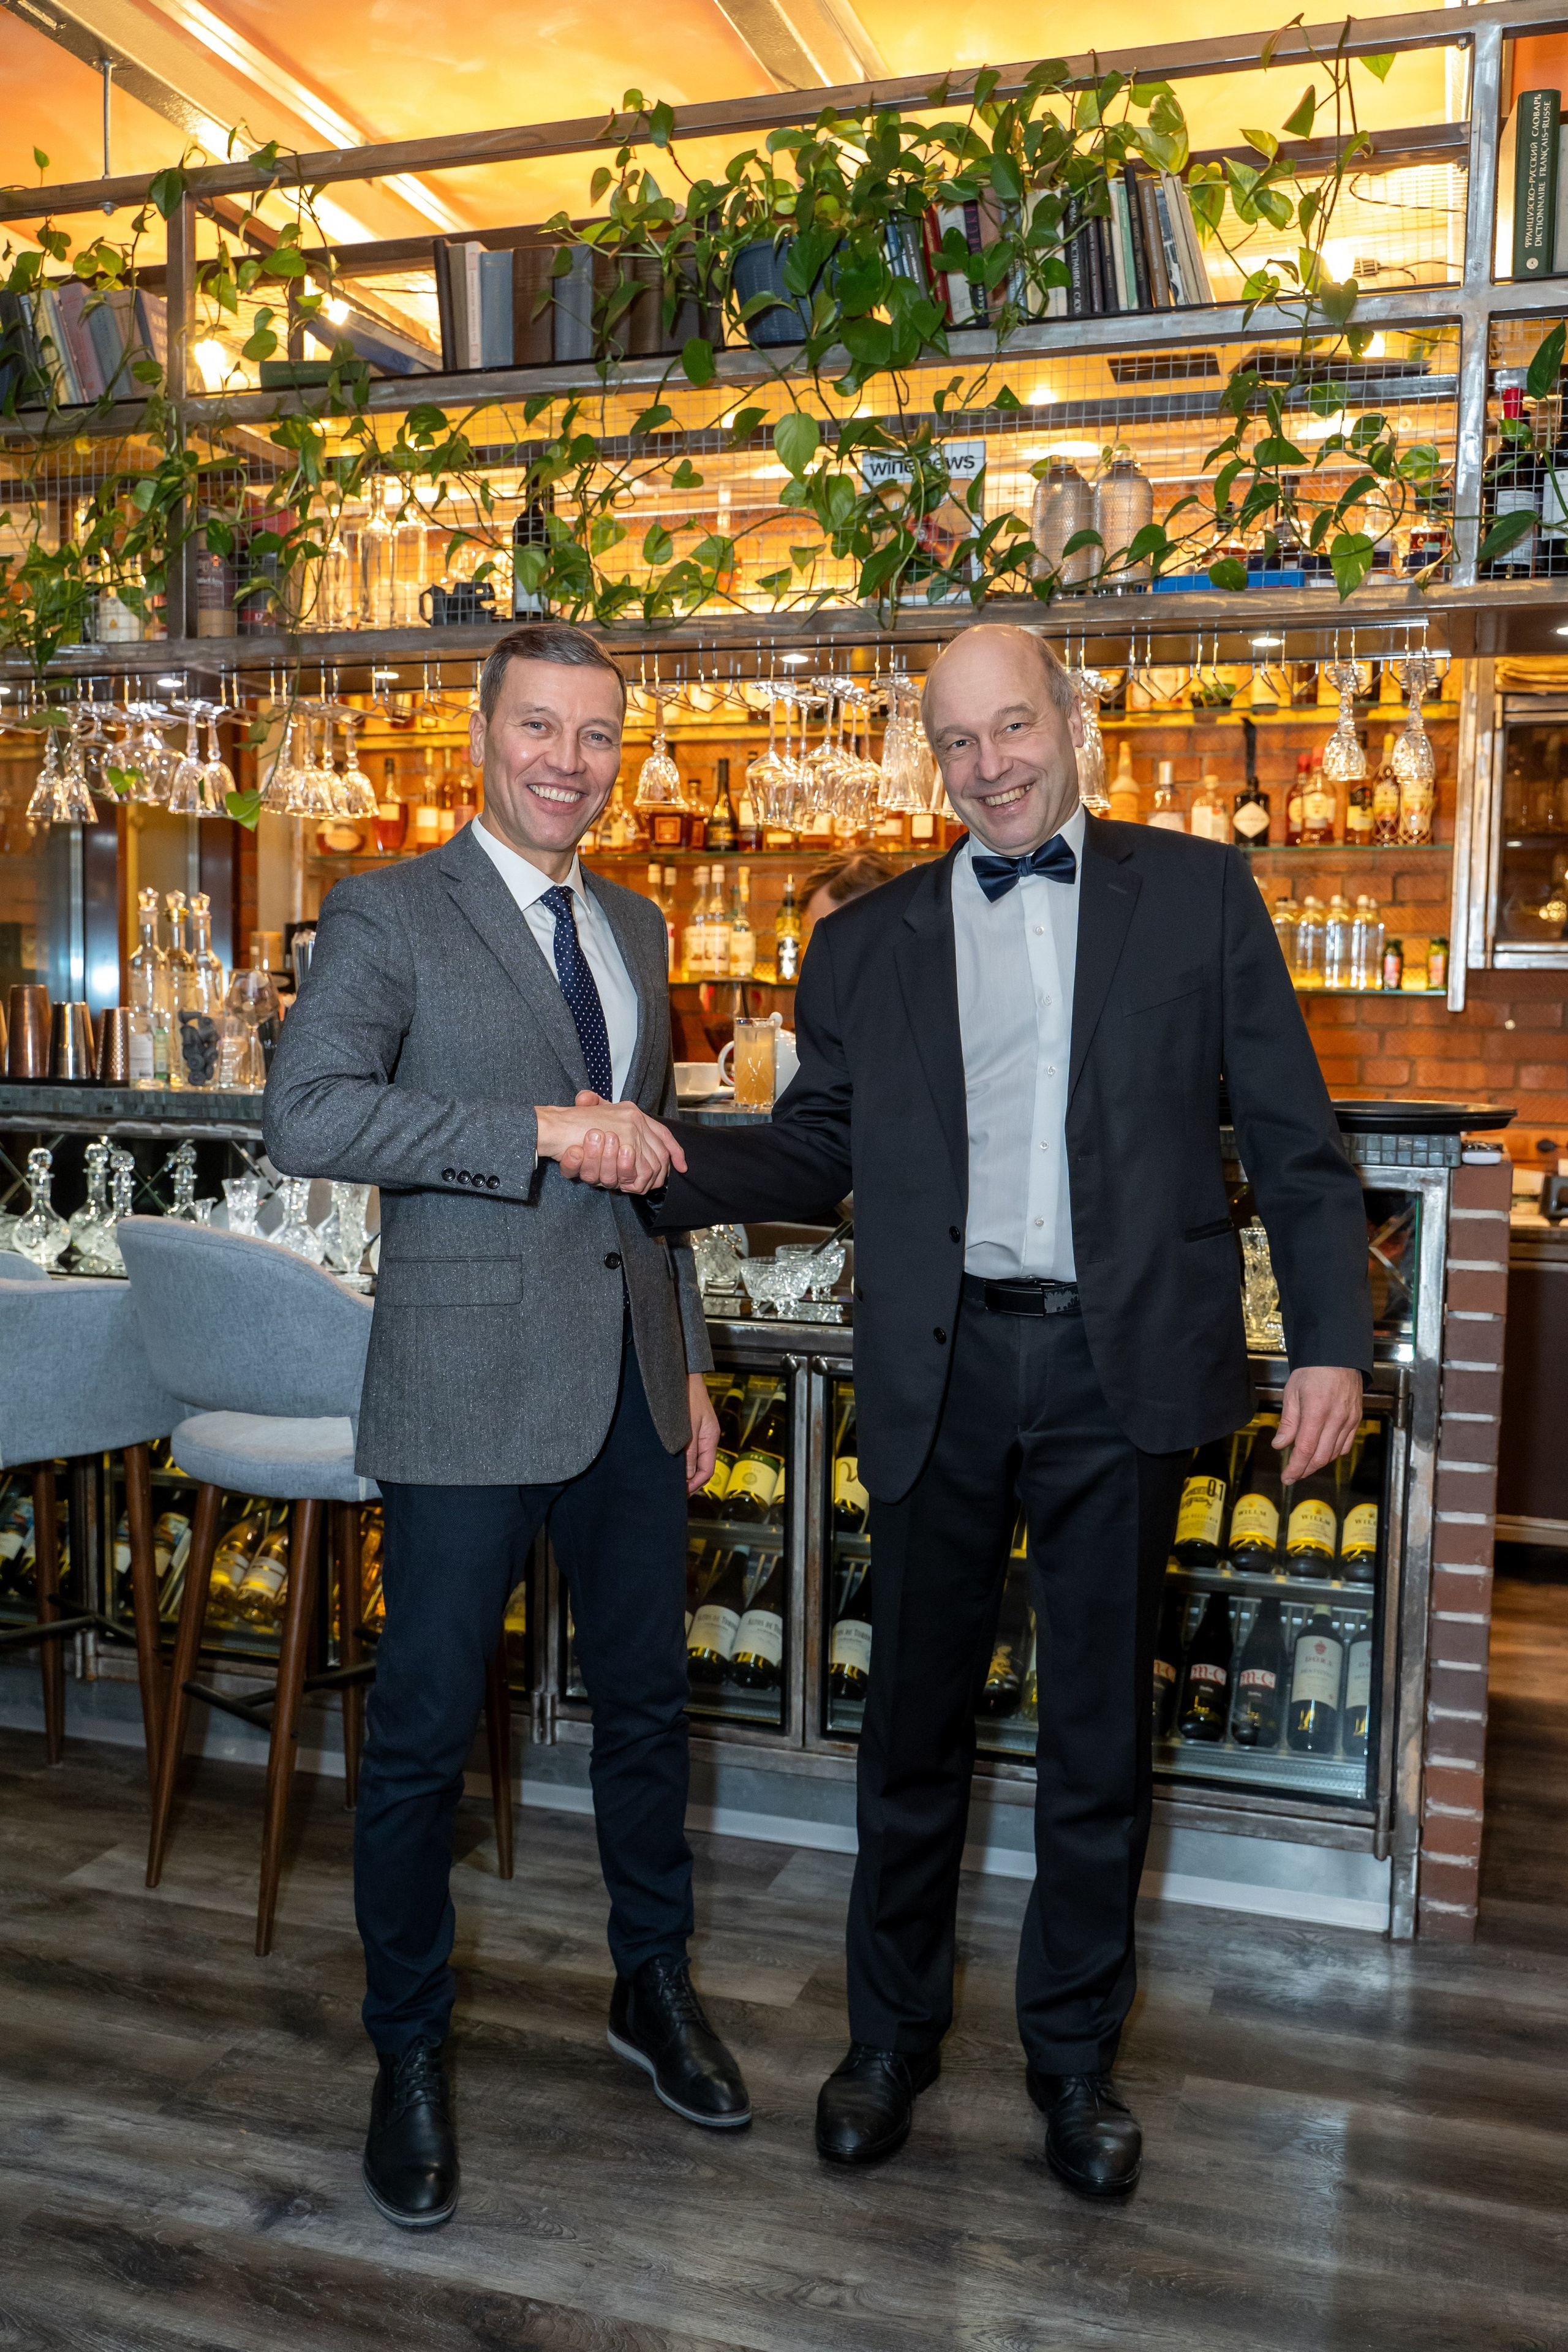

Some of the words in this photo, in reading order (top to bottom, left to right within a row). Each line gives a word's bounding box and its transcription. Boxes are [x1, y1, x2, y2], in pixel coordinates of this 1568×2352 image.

[1531, 94, 1542, 138] СЛОВАРЬ
[1539, 100, 1552, 177] FRANÇAIS-RUSSE
[1525, 141, 1539, 249] ФРАНЦУЗСКО-РУССКИЙ
[1534, 181, 1547, 247] DICTIONNAIRE
